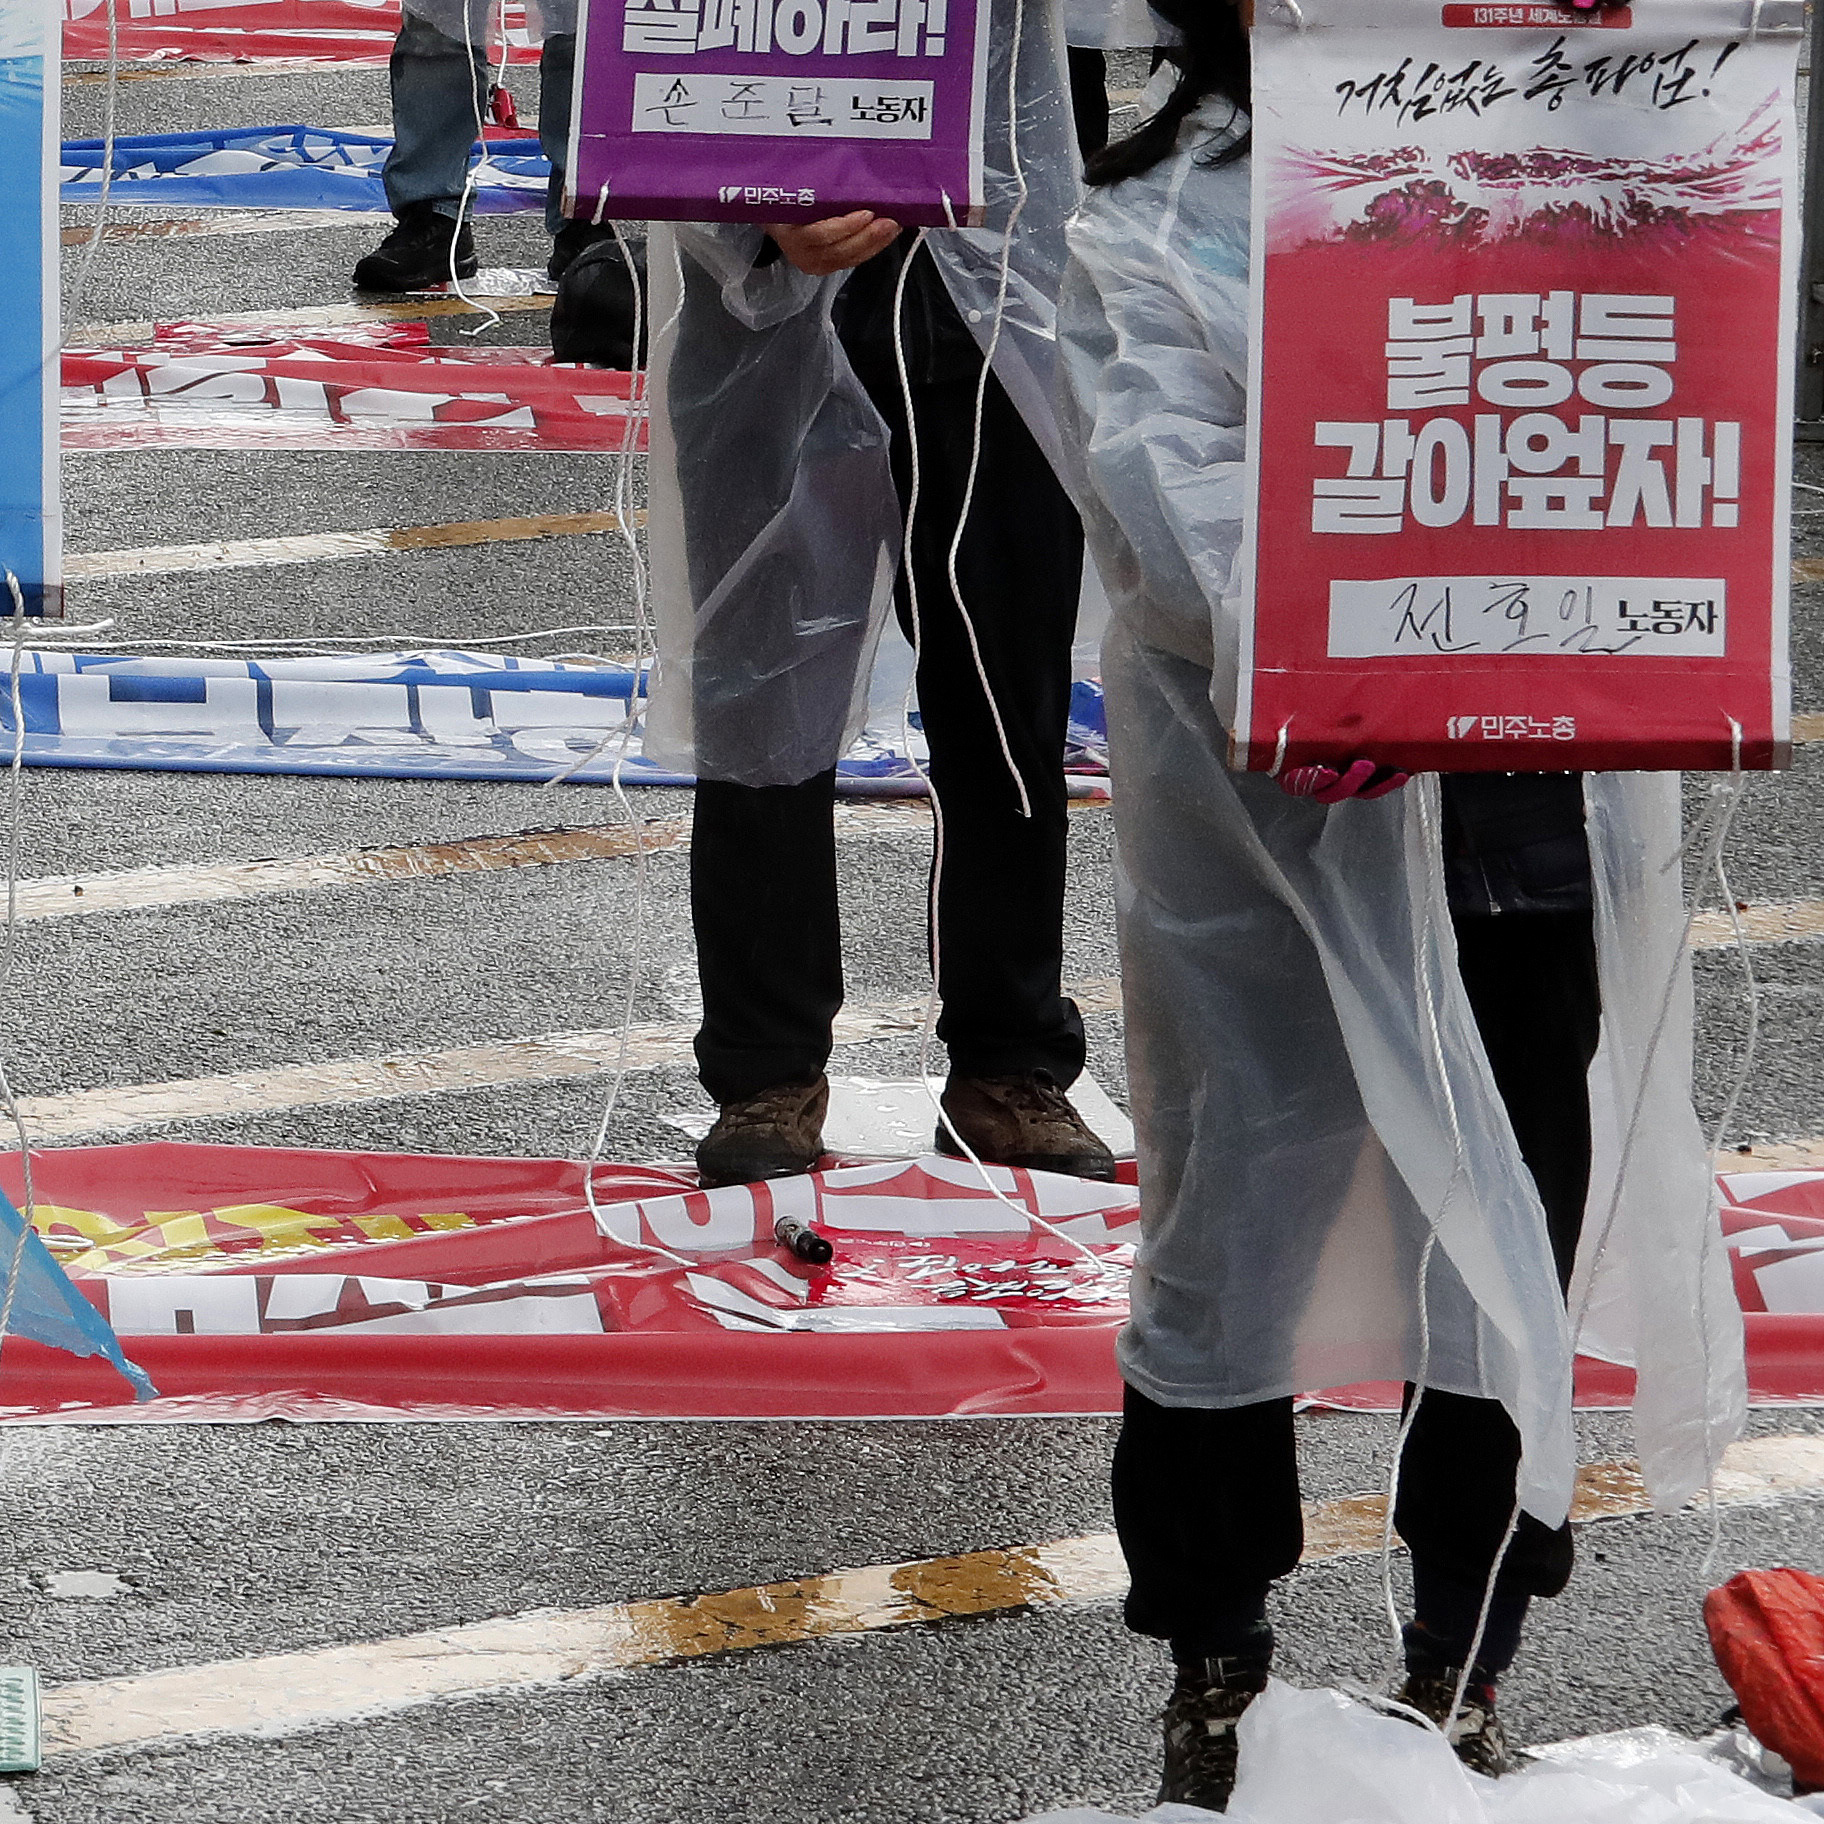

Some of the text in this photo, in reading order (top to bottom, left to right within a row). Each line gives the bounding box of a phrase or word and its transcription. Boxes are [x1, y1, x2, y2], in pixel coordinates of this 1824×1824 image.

[1472, 5, 1525, 27] 131주년
[849, 95, 929, 125] 노동자
[1334, 55, 1520, 130] 거침없는
[743, 185, 817, 206] 민주노총
[1384, 288, 1678, 412] 불평등
[1310, 413, 1743, 536] 갈아엎자!
[1617, 596, 1720, 638] 노동자
[1480, 714, 1578, 742] 민주노총
